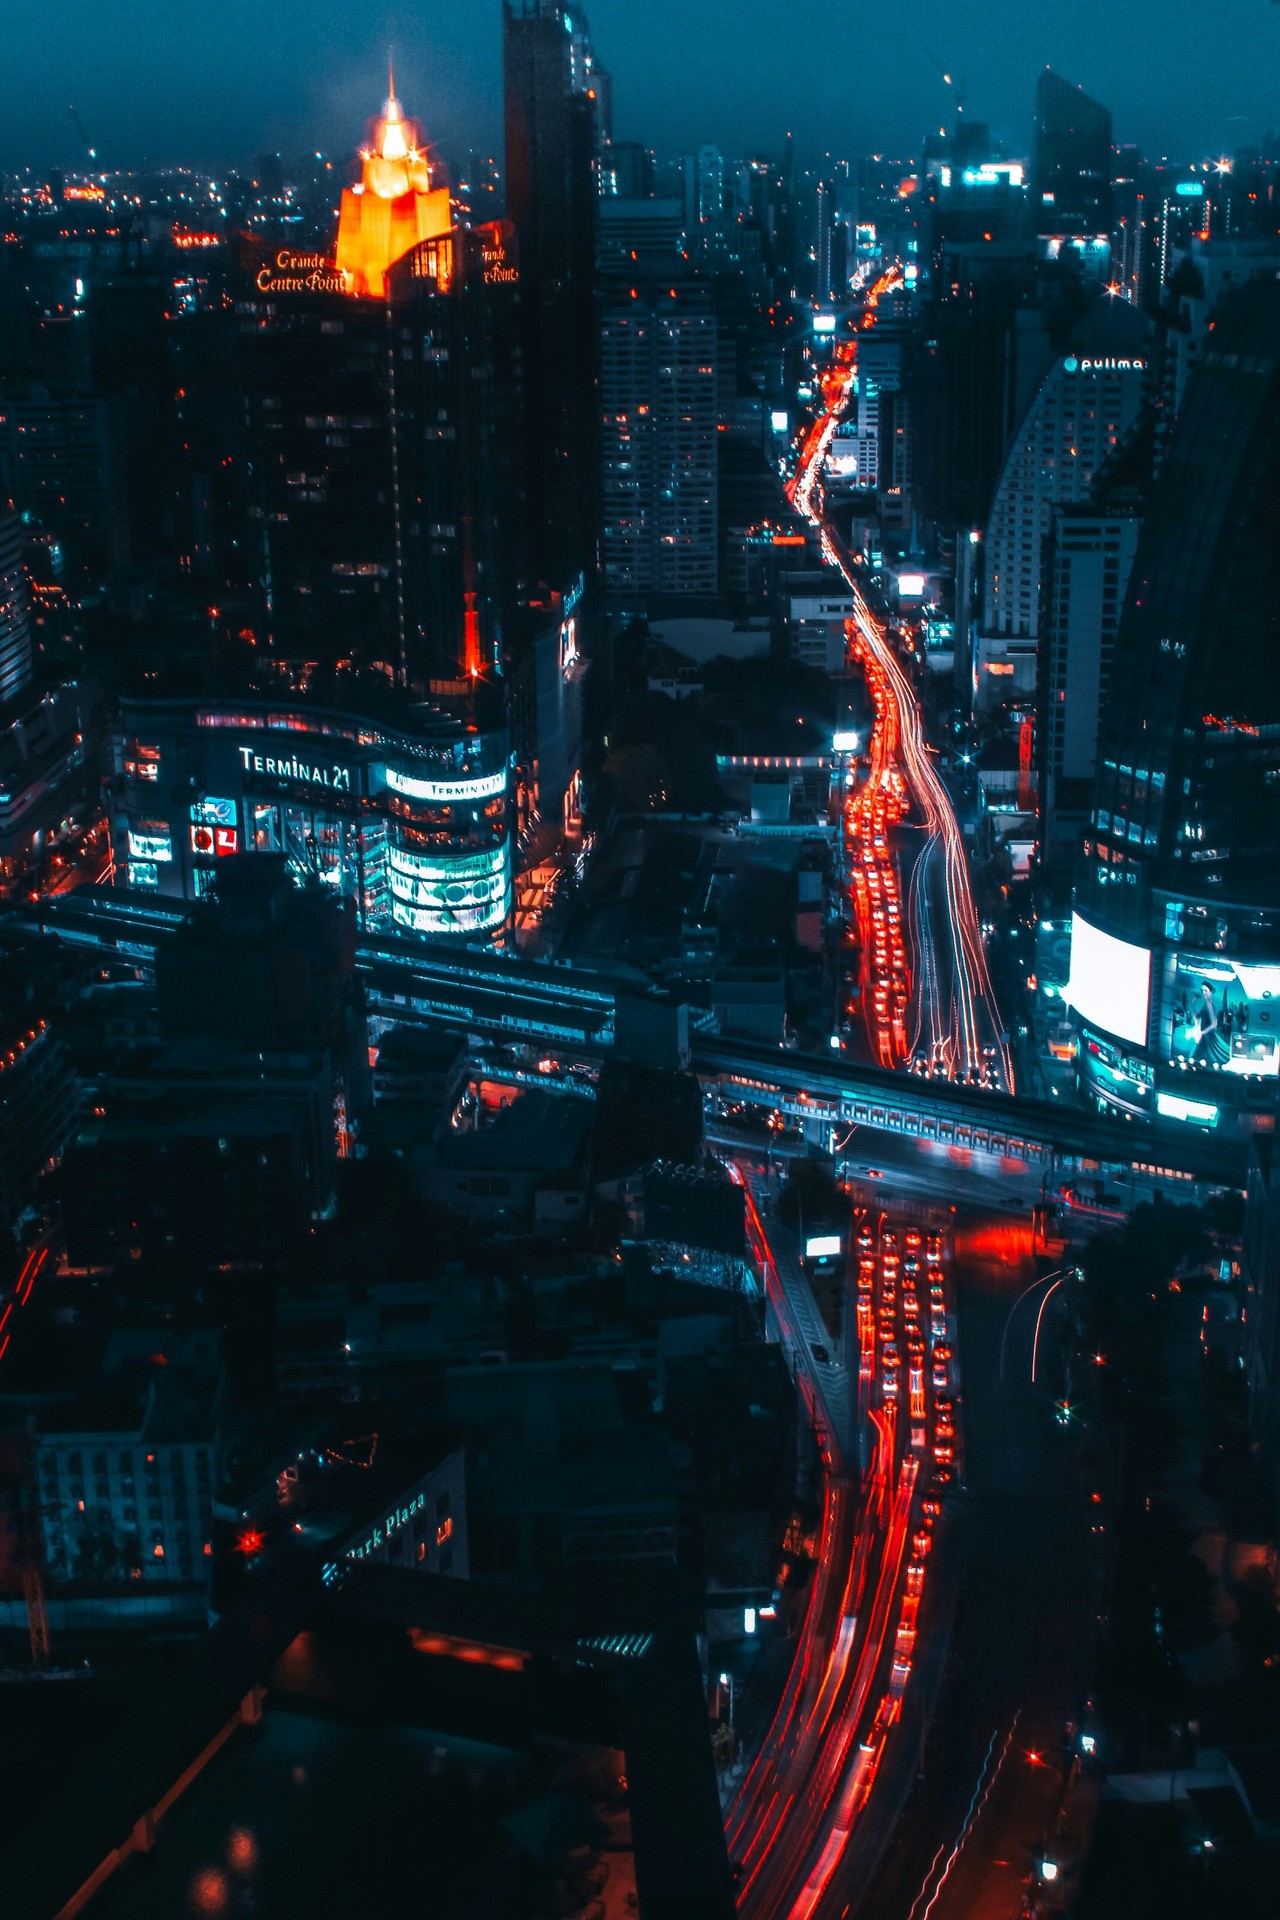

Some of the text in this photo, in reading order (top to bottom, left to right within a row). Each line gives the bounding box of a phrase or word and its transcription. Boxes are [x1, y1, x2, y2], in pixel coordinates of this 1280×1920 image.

[276, 250, 325, 269] Grande
[482, 246, 506, 261] rande
[256, 268, 346, 291] Centre Point
[385, 1493, 425, 1537] Plaza
